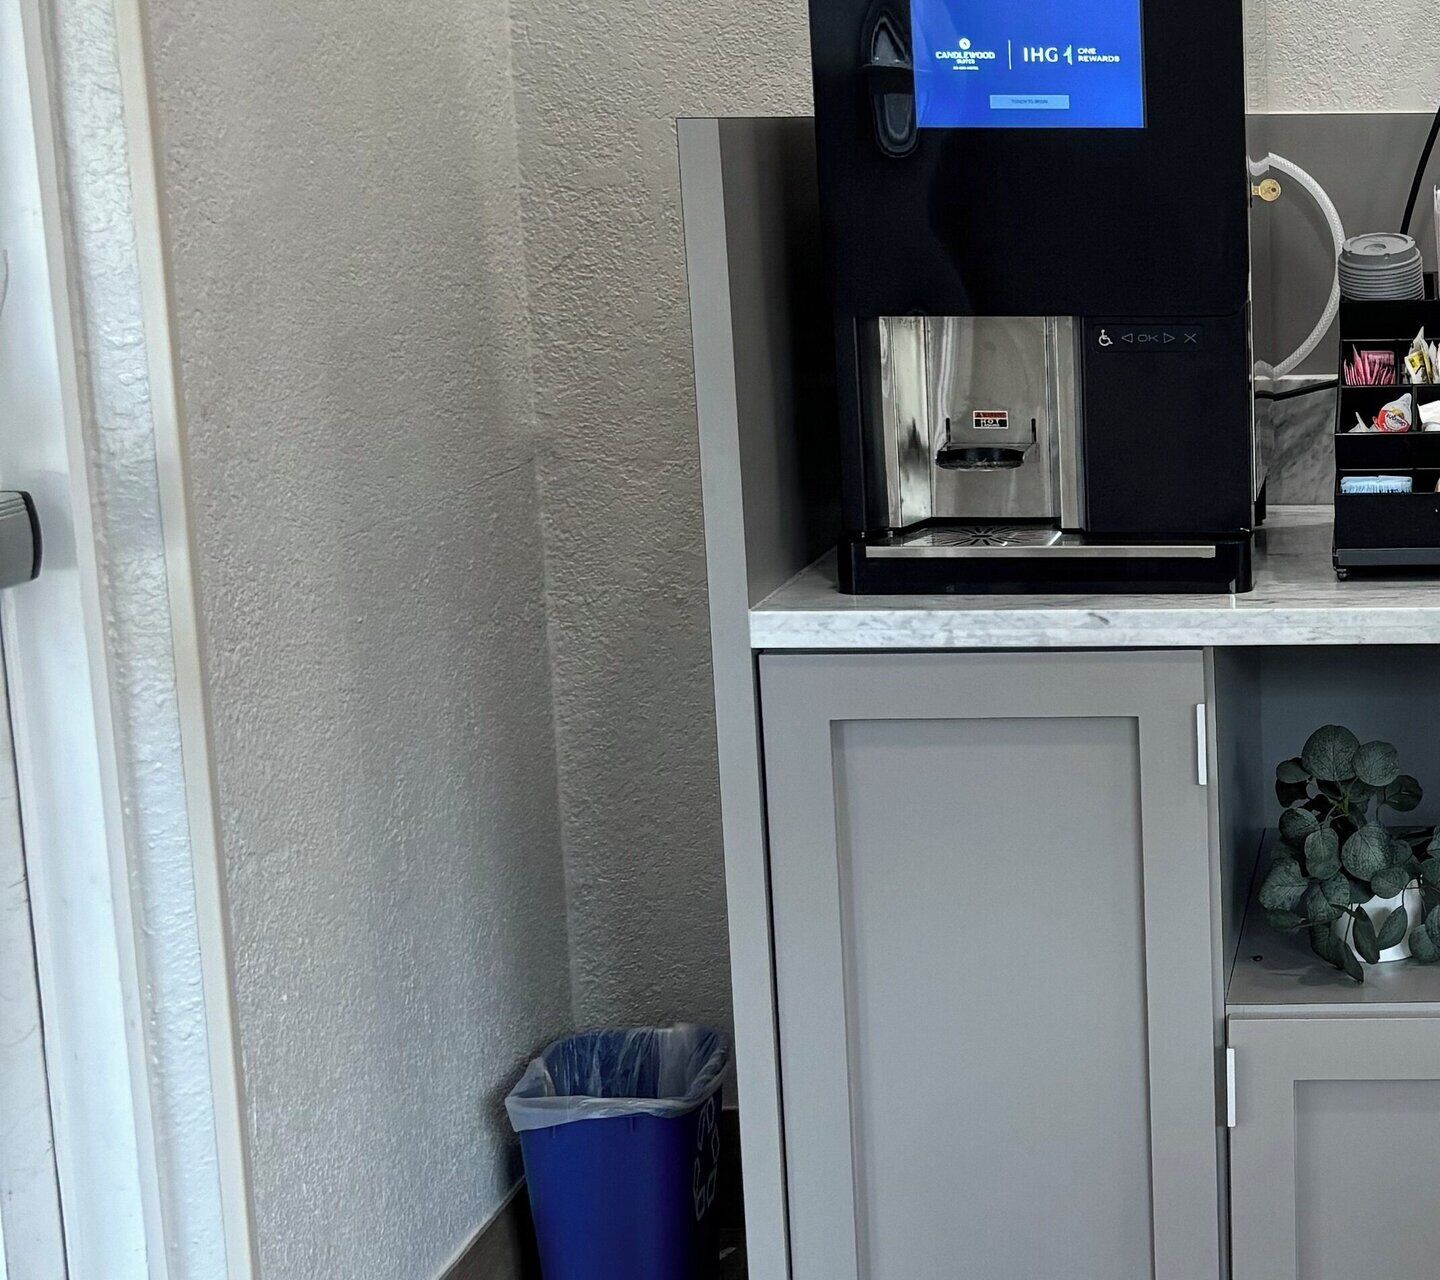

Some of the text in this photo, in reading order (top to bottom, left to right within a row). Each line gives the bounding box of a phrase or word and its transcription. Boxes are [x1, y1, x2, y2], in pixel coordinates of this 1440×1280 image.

[935, 51, 996, 59] CANDLEWOOD
[1023, 47, 1058, 62] IHG
[1077, 47, 1097, 55] ONE
[1078, 55, 1120, 63] REWARDS
[1137, 334, 1159, 342] OK
